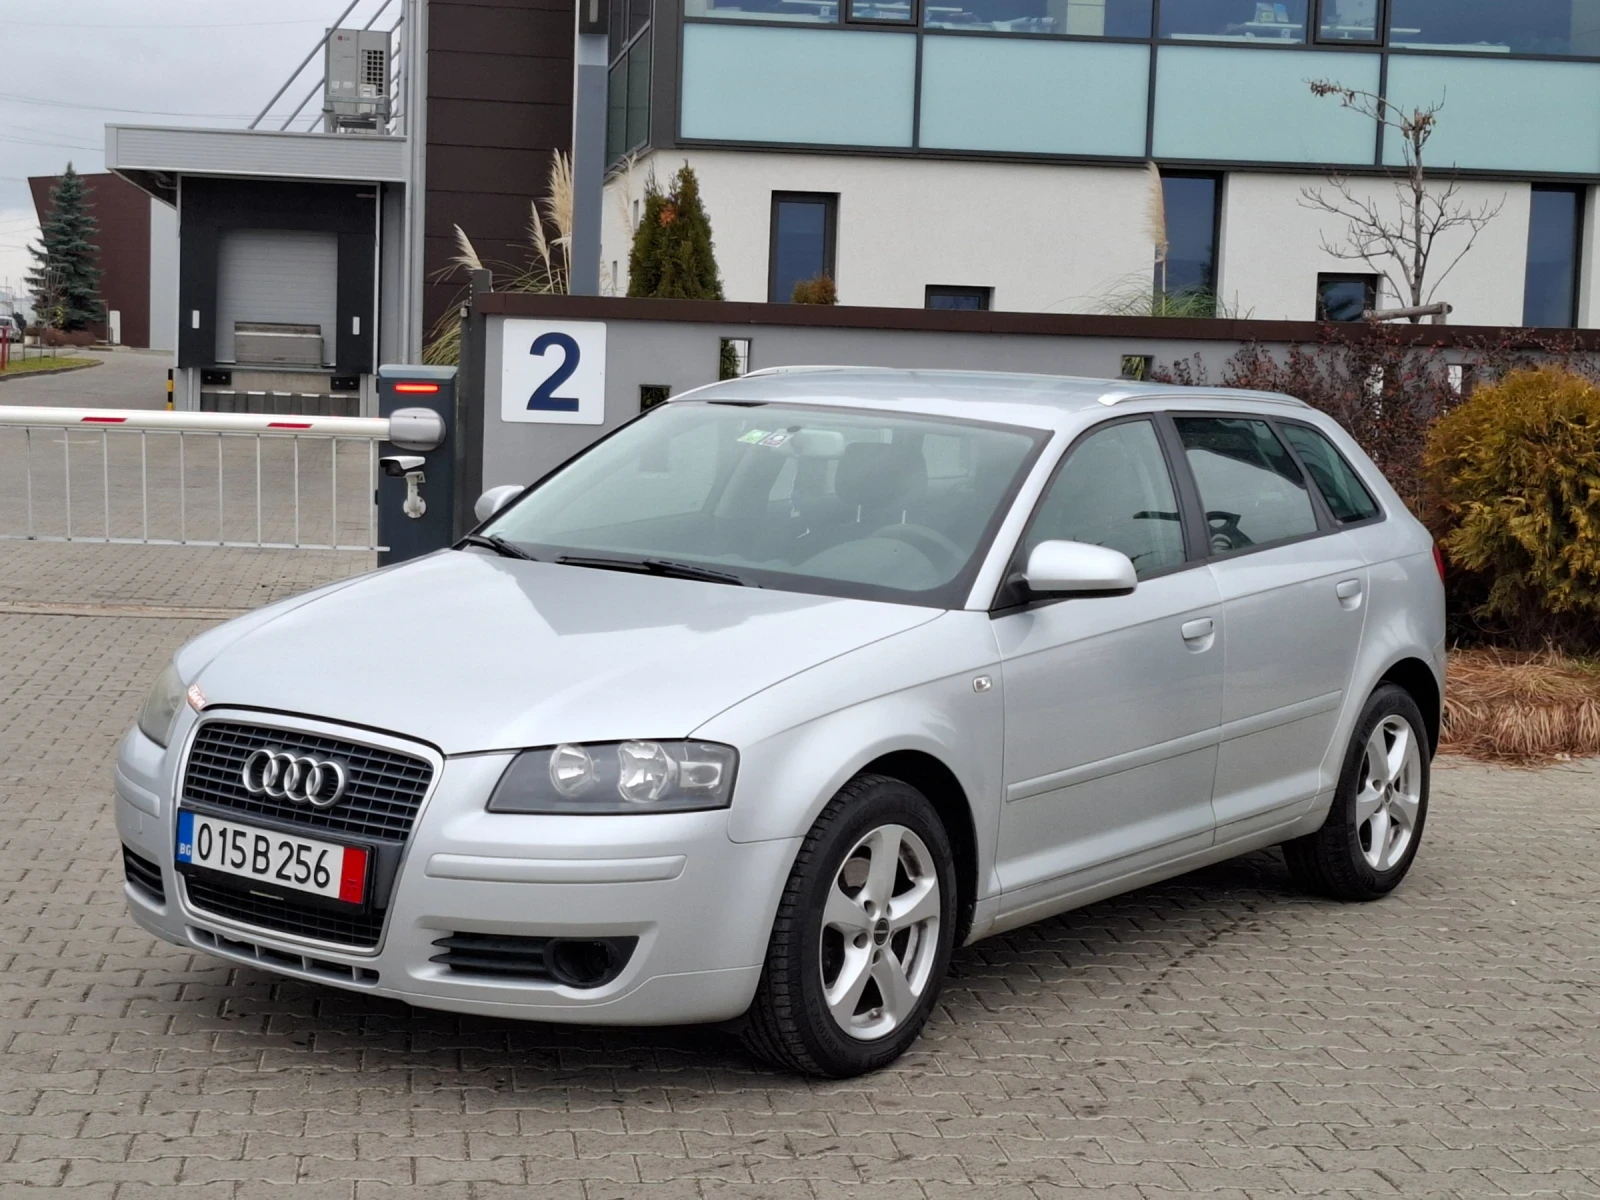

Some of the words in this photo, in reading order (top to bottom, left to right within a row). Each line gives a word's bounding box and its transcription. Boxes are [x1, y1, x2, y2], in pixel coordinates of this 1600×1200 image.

[526, 332, 581, 412] 2
[179, 842, 191, 856] BG
[197, 822, 331, 888] 015B256
